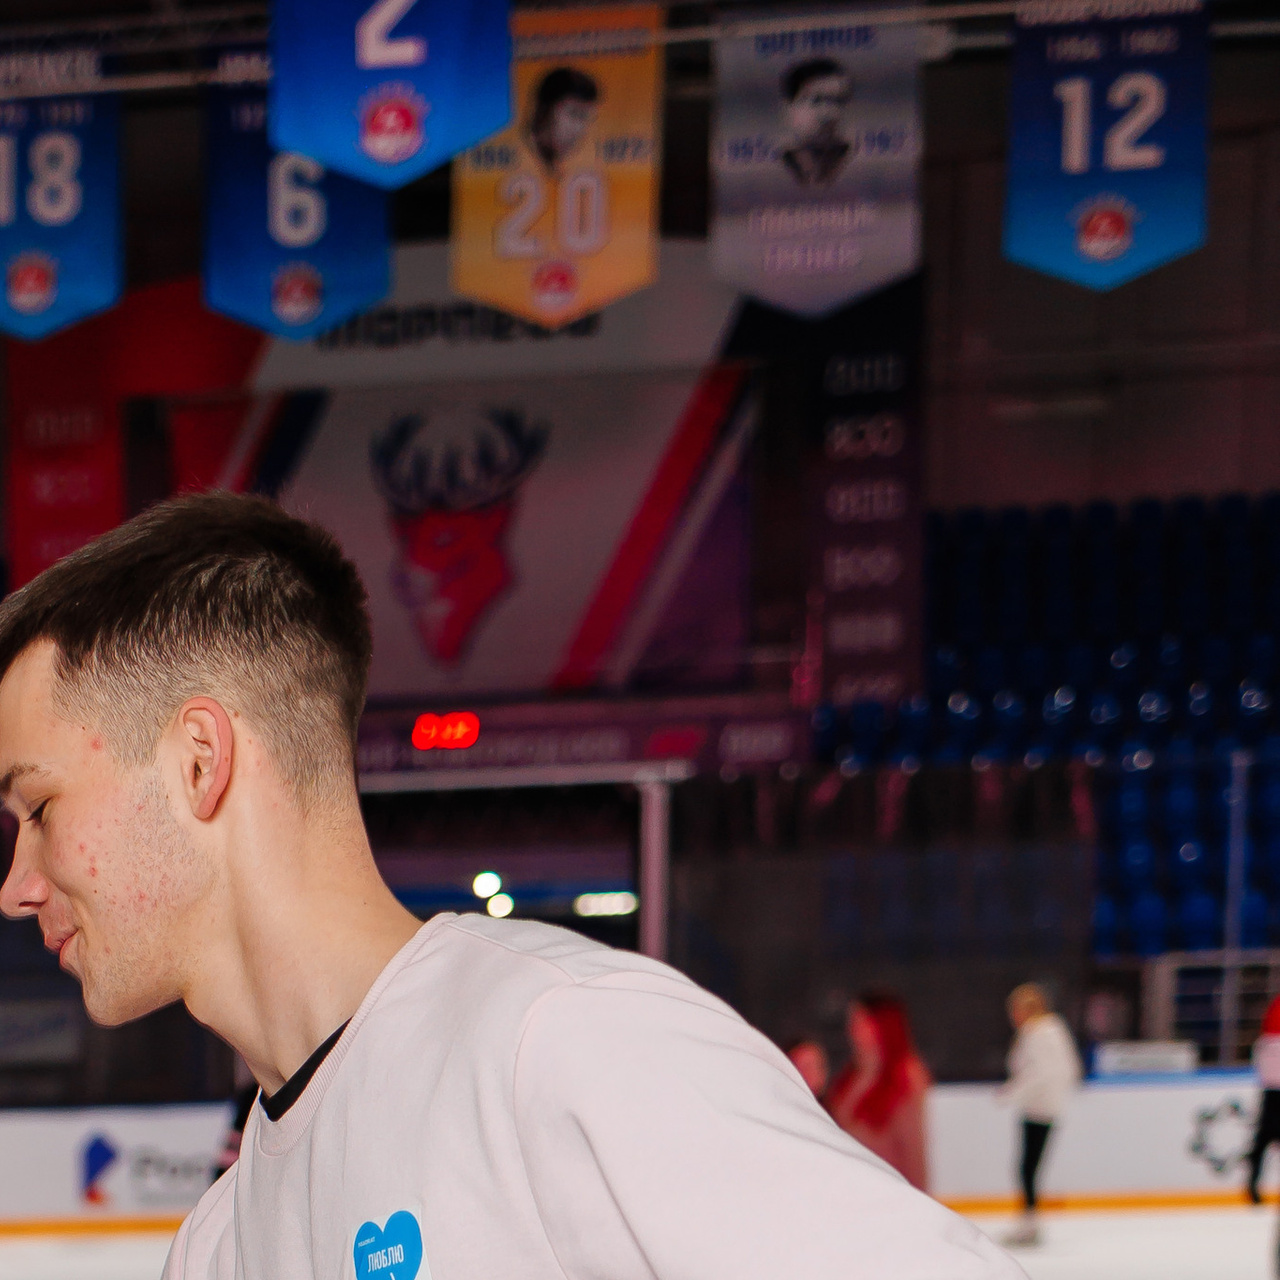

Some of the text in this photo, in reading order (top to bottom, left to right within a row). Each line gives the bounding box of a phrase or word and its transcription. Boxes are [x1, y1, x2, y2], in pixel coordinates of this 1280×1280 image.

[354, 0, 428, 69] 2
[1052, 71, 1169, 175] 12
[266, 152, 328, 248] 6
[492, 170, 611, 260] 20
[367, 1243, 404, 1273] ЛЮБЛЮ
